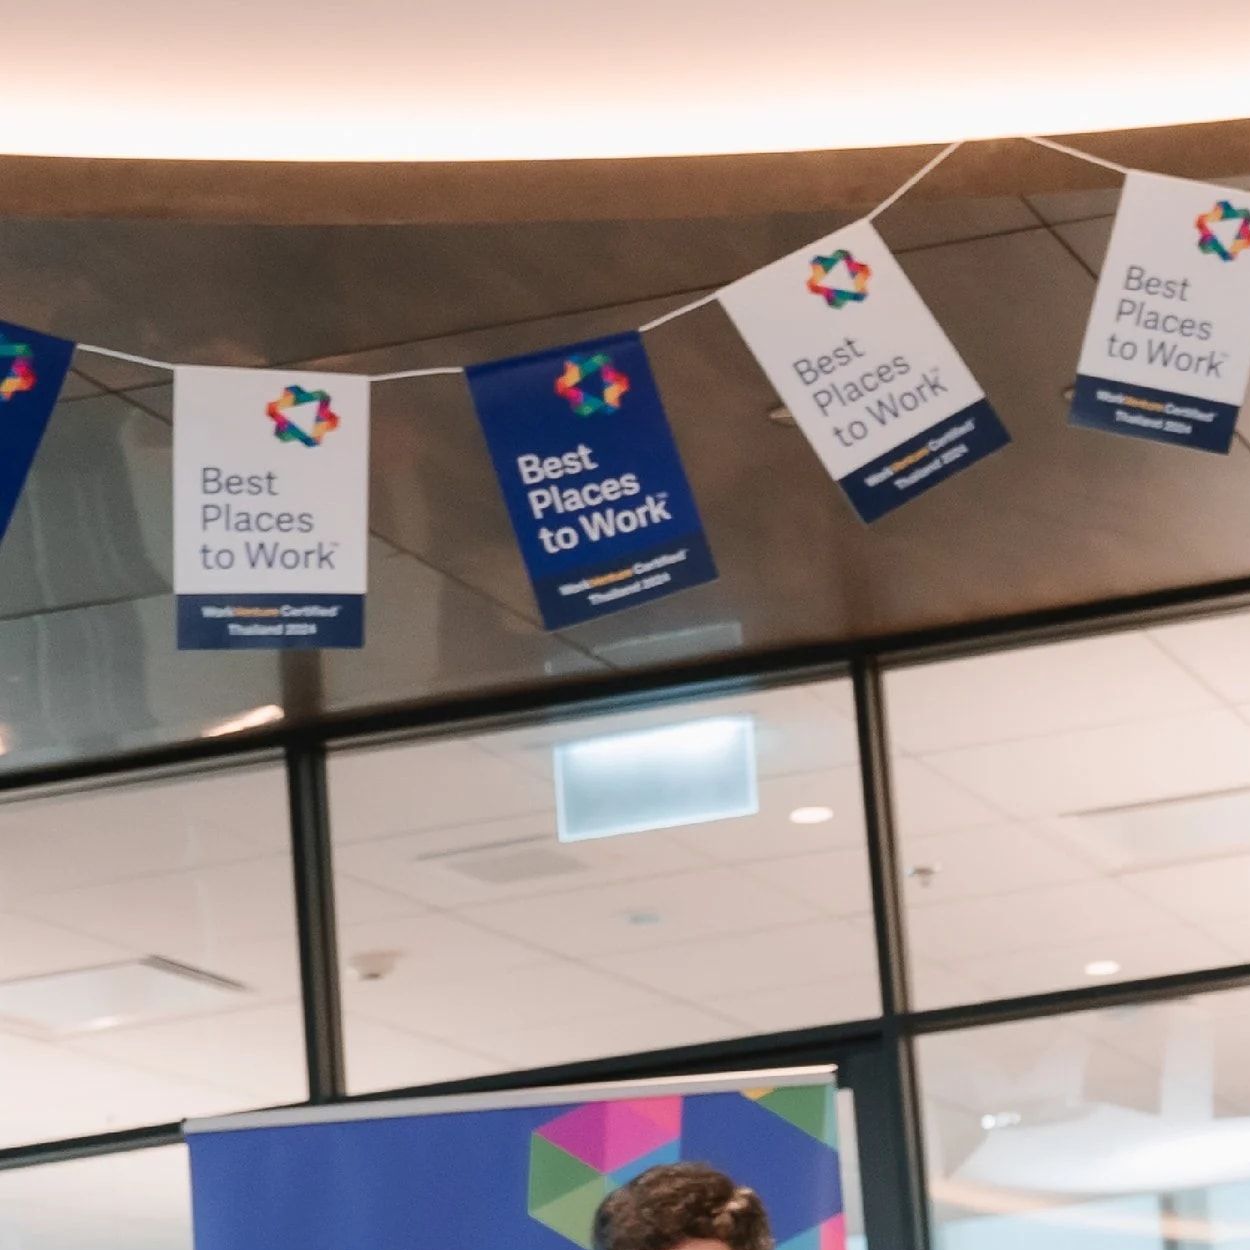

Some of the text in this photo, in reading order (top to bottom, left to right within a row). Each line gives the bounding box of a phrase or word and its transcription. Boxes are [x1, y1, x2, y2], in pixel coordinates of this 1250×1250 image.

[1123, 264, 1191, 302] Best
[1115, 299, 1214, 341] Places
[793, 337, 865, 386] Best
[1107, 333, 1138, 361] to
[812, 355, 911, 417] Places
[832, 419, 869, 448] to
[516, 443, 599, 485] Best
[202, 467, 279, 496] Best
[527, 472, 641, 519] Places
[202, 503, 315, 533] Places
[538, 525, 580, 554] to
[200, 544, 236, 570] to
